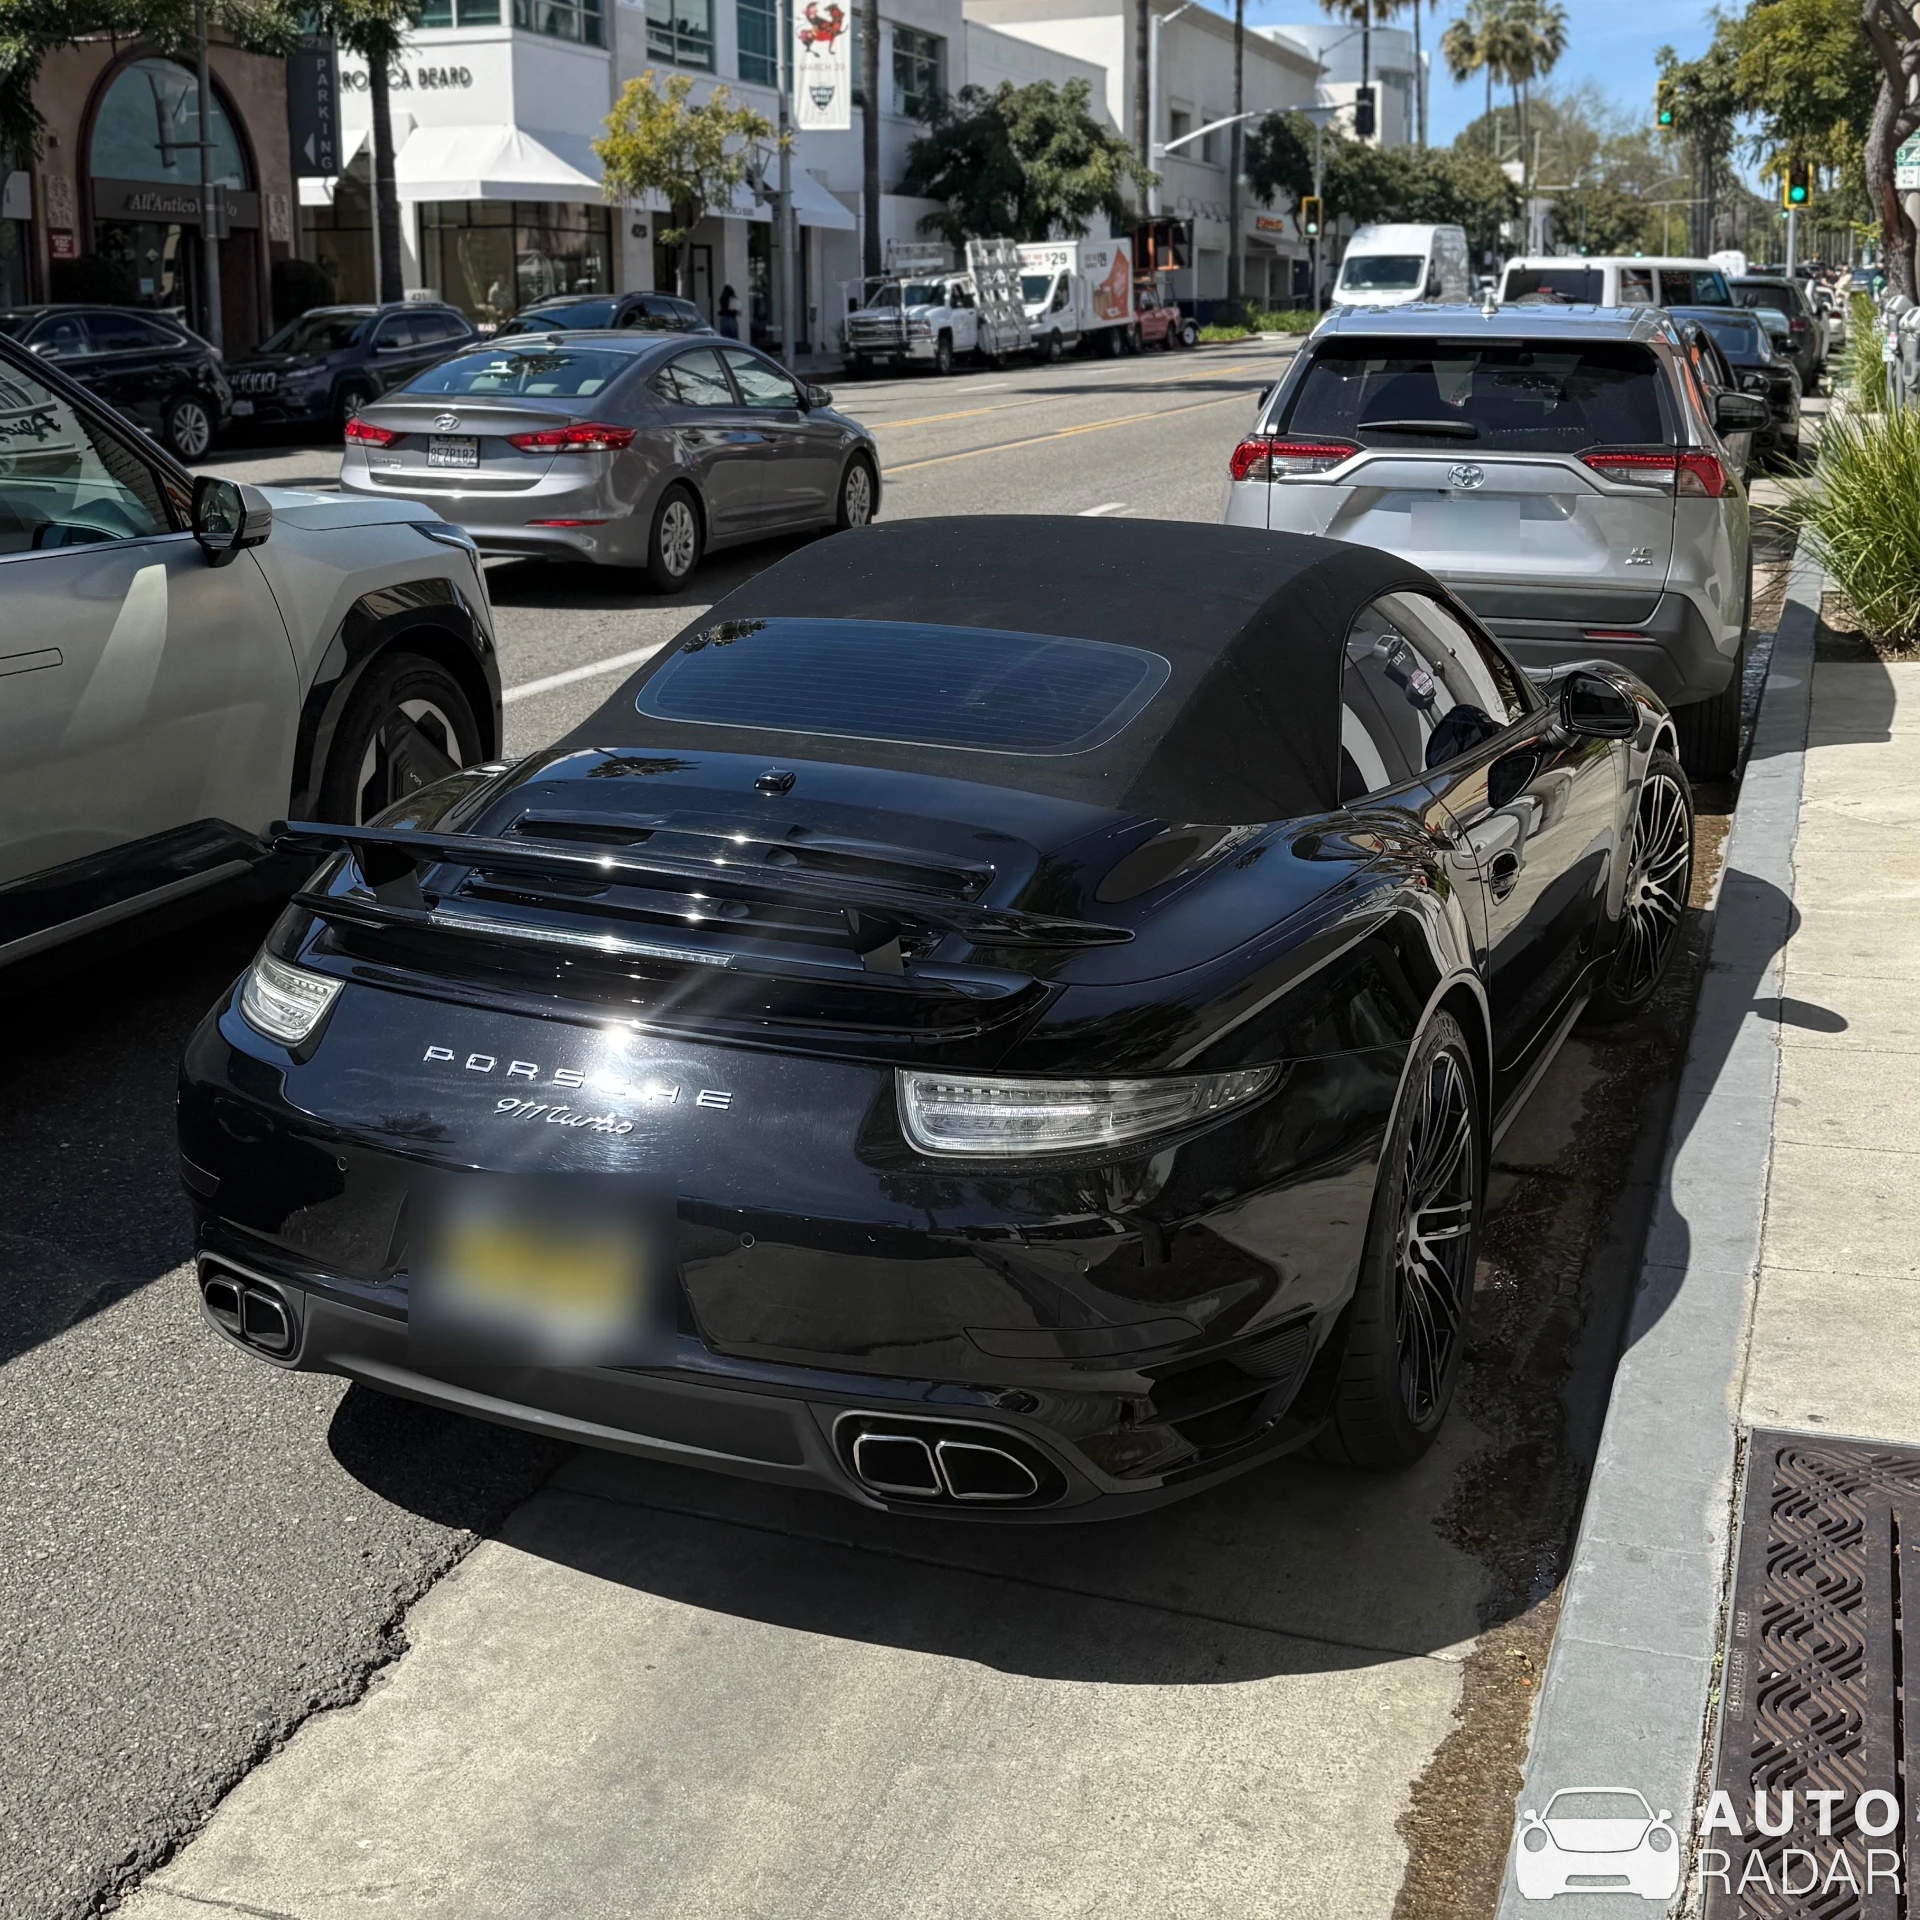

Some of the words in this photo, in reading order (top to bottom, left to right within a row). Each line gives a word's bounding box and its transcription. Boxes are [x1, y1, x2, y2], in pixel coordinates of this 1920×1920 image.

[418, 66, 472, 88] BEARD
[316, 58, 333, 169] PARKING
[130, 192, 195, 214] All'Antico
[1044, 252, 1067, 265] $29
[411, 292, 426, 301] 421
[423, 1045, 734, 1111] PORSCHE
[494, 1098, 548, 1120] 911
[546, 1105, 634, 1135] turbo
